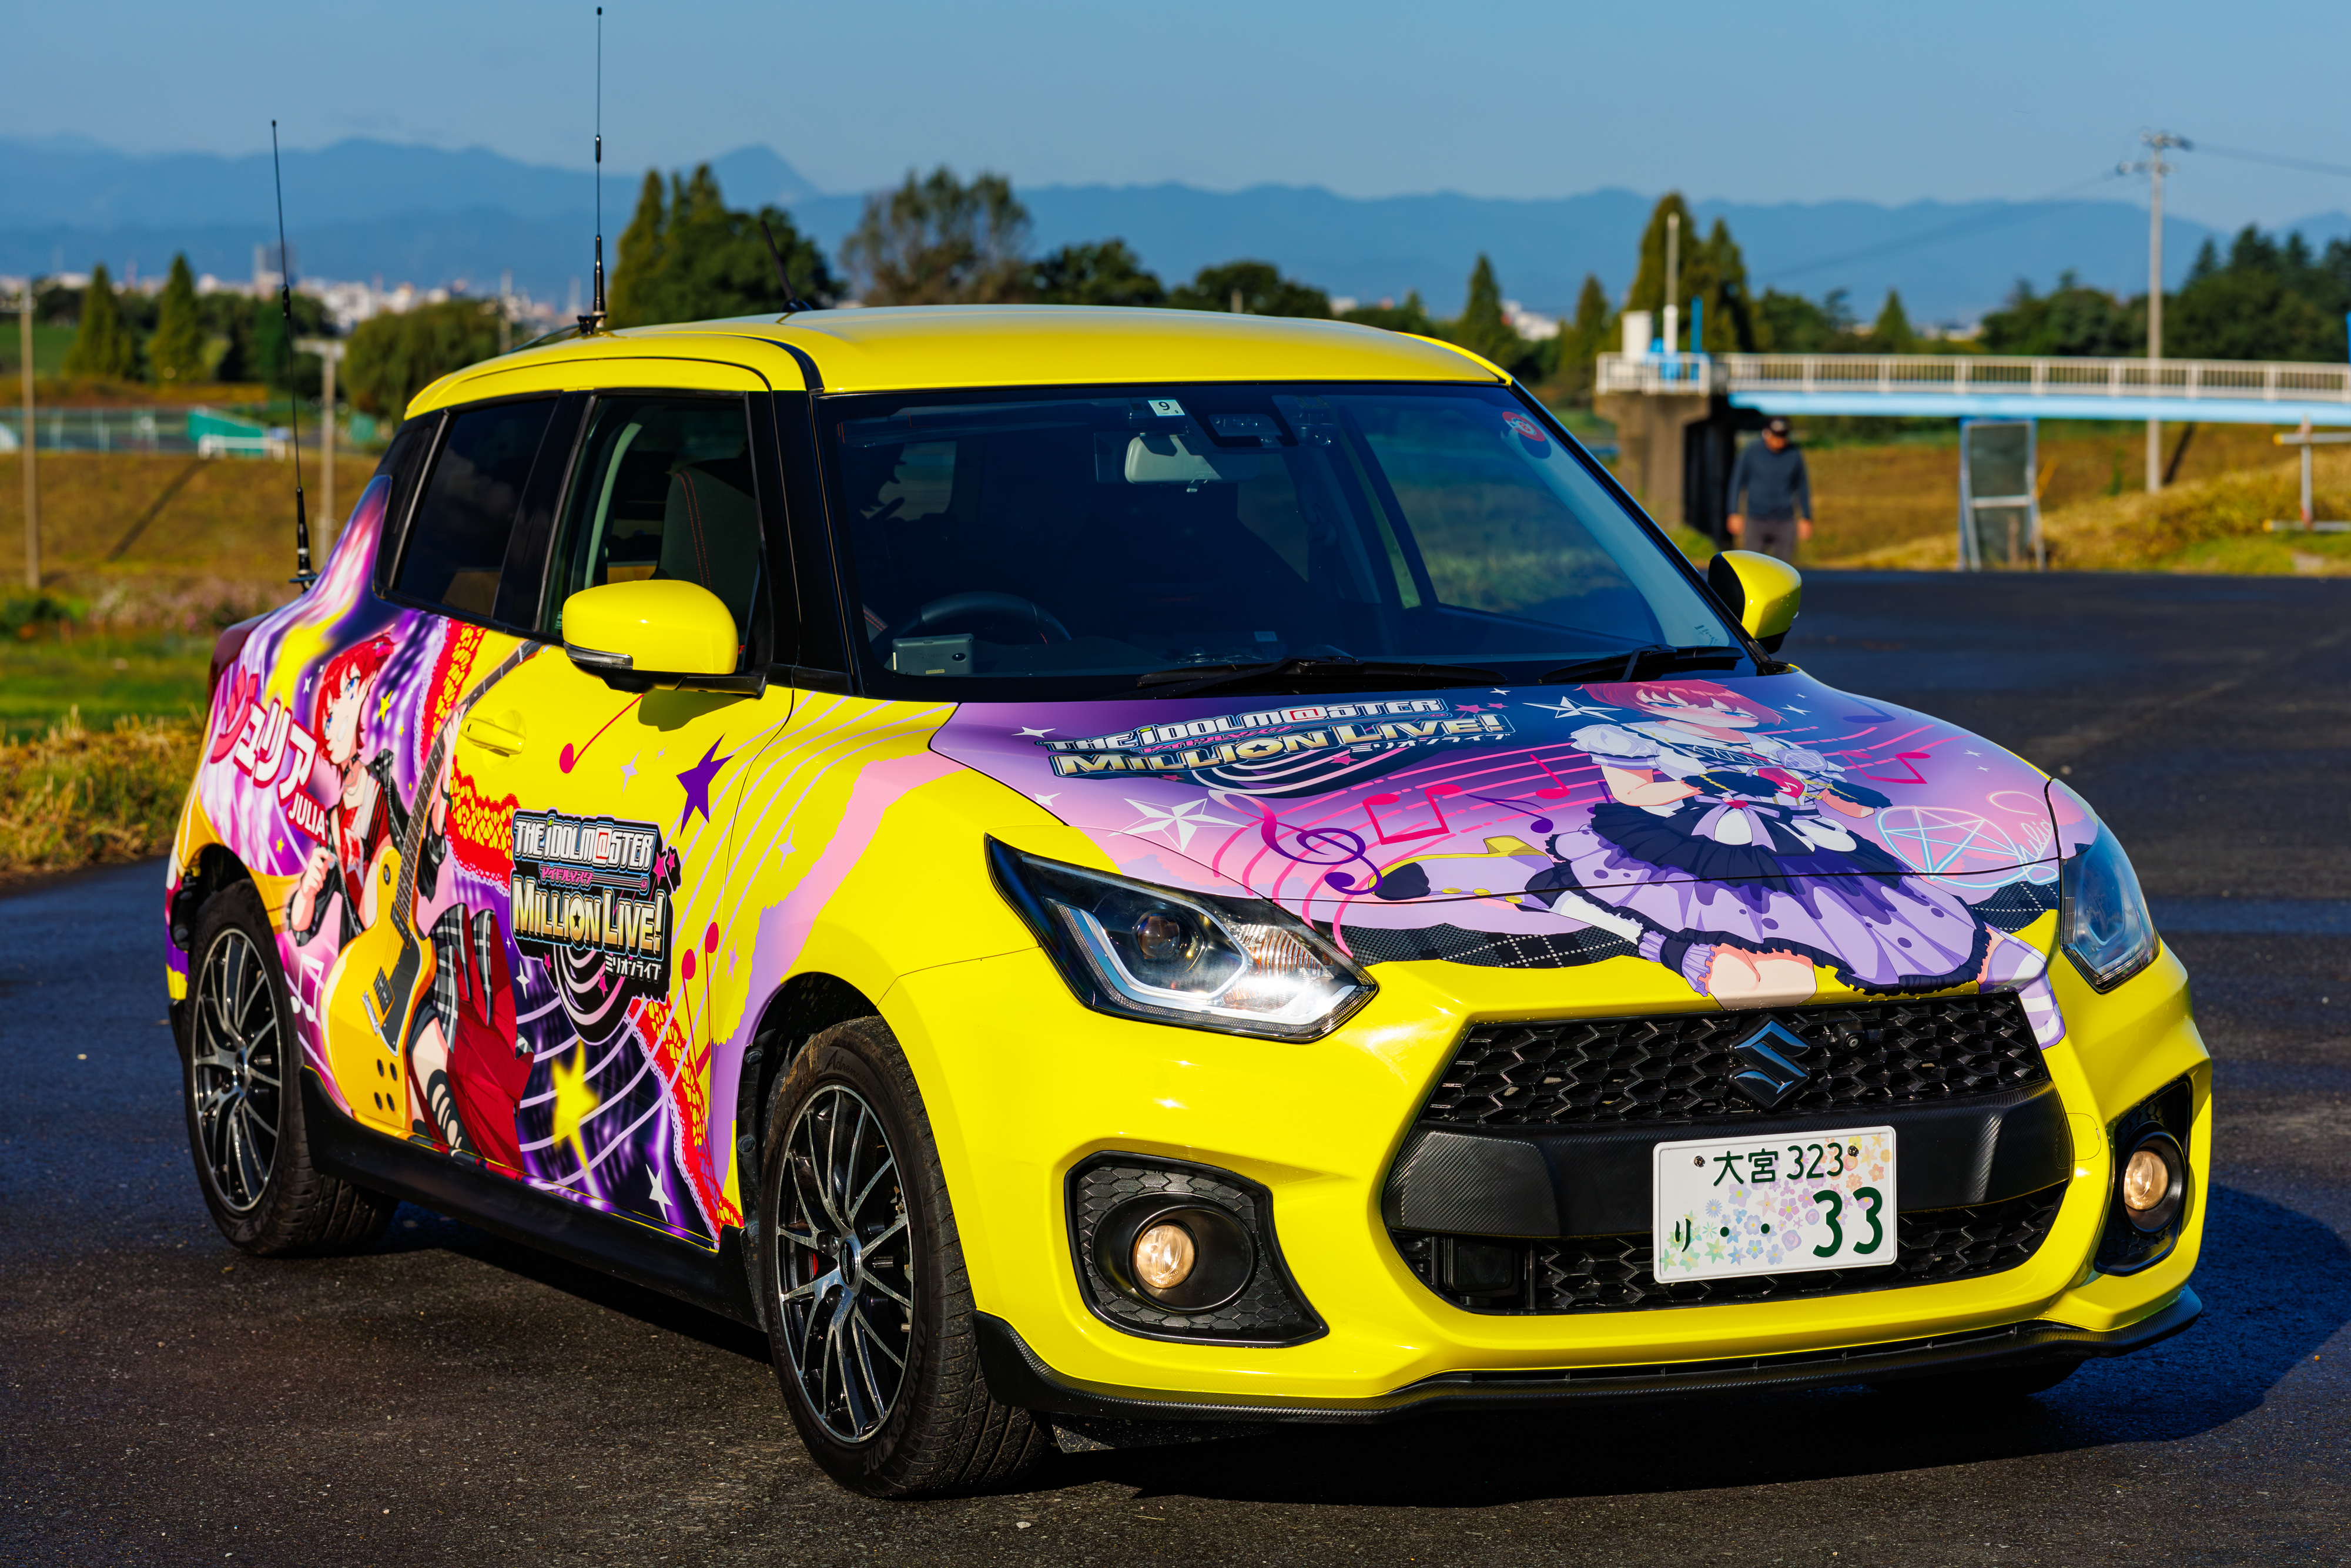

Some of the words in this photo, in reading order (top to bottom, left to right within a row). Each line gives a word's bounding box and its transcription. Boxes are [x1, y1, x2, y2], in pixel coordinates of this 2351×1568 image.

[1158, 401, 1170, 411] 9
[1041, 733, 1137, 751] THE
[1055, 731, 1330, 776] MILLION
[1332, 714, 1503, 745] LIVE!
[1350, 733, 1511, 753] ミリオンライブ
[287, 792, 326, 841] JULIA
[515, 819, 545, 857] THE
[513, 877, 602, 944] MILLION
[602, 888, 665, 953] LIVE!
[605, 954, 662, 981] ミリオンライブ
[1713, 1148, 1779, 1187] 大宮
[1786, 1142, 1844, 1180] 323
[1674, 1218, 1692, 1253] り
[1812, 1186, 1883, 1258] 33
